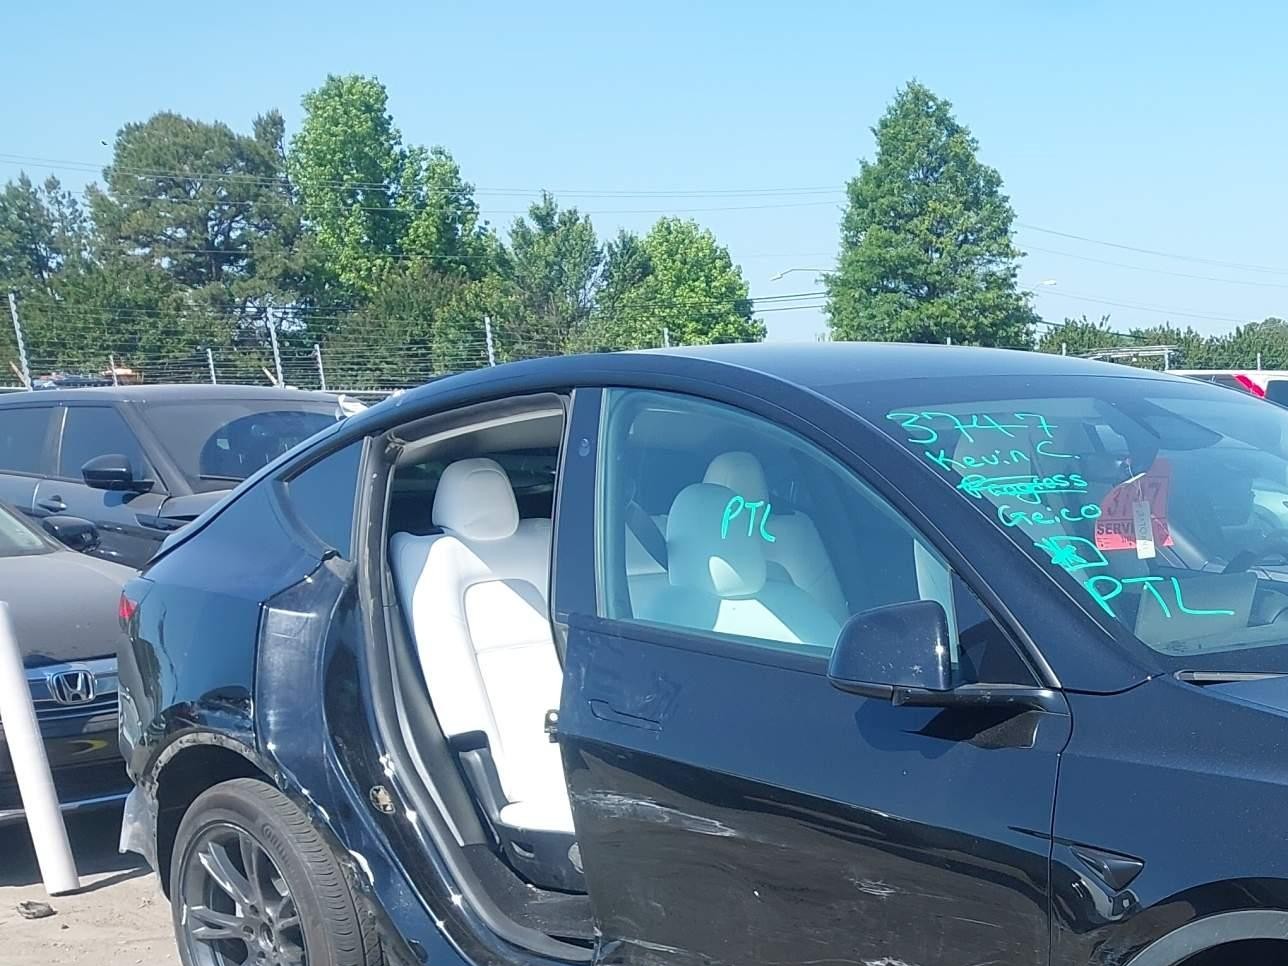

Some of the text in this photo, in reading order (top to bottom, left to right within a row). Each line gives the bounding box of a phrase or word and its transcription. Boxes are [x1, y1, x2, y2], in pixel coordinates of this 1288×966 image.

[886, 411, 1057, 444] 3747
[924, 448, 1029, 471] Kevin
[720, 495, 777, 543] PTL
[997, 503, 1103, 527] Geico
[1083, 575, 1235, 618] PTL
